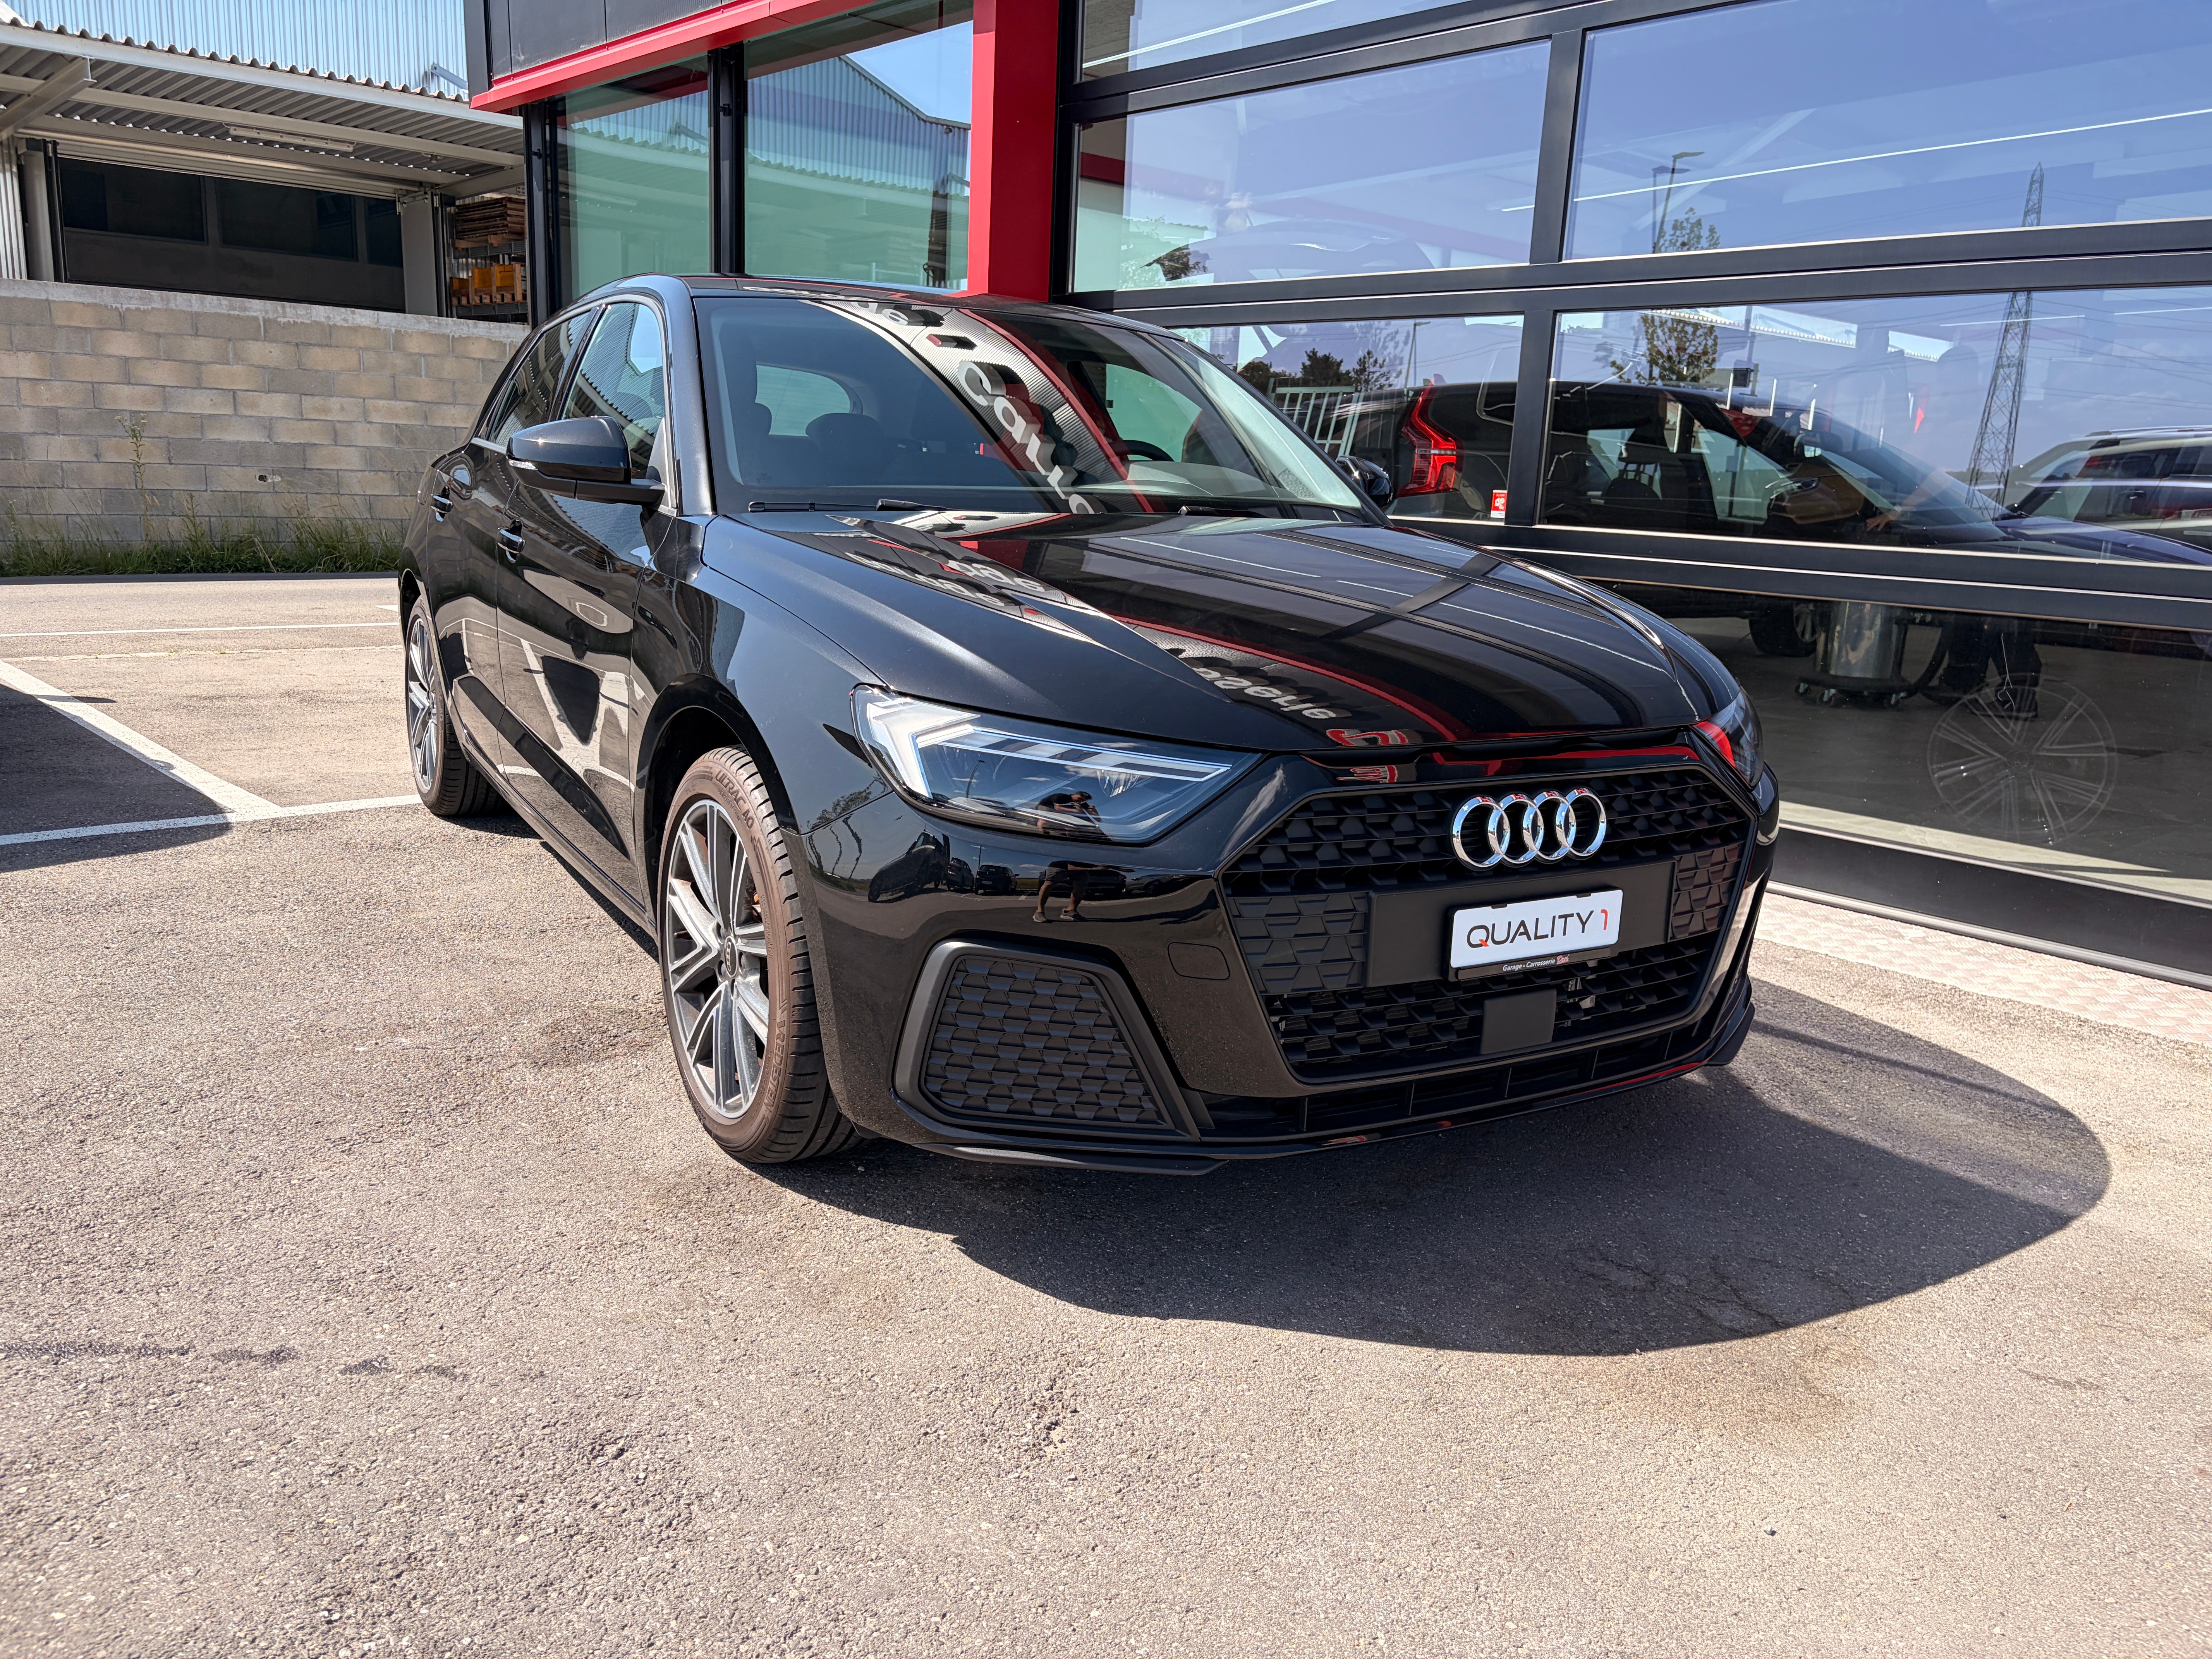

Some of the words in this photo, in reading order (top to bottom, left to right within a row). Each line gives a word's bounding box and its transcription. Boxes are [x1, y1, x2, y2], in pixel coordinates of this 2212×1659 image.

[715, 770, 746, 810] ULTRAC
[1467, 910, 1594, 948] QUALITY
[1526, 958, 1556, 968] Carrosserie
[764, 1020, 785, 1113] VREDESTEIN
